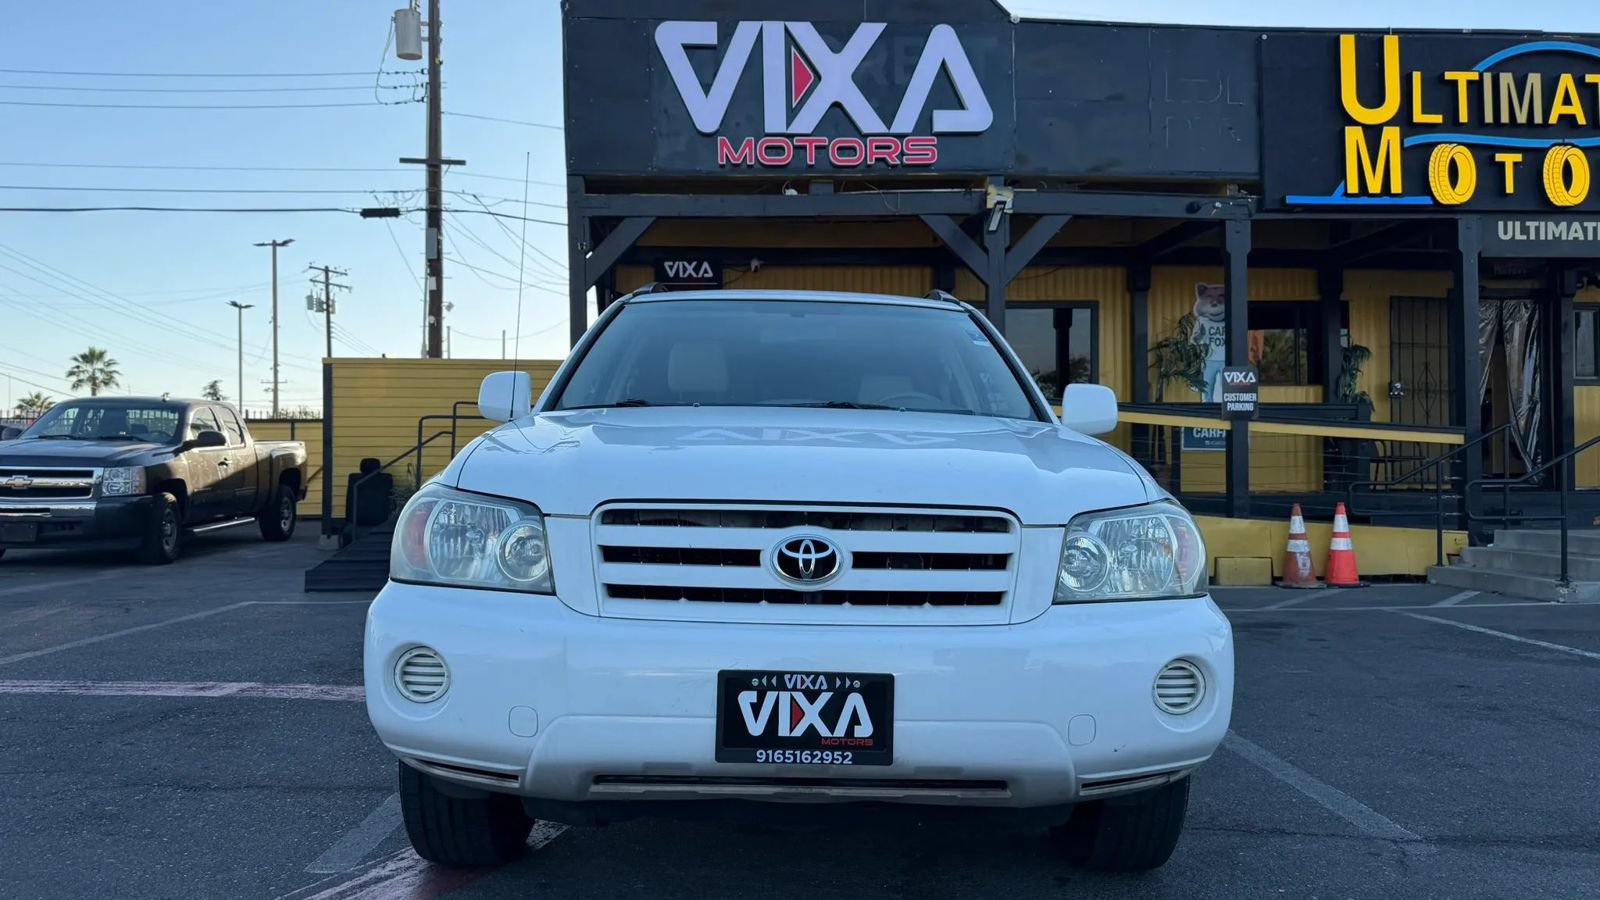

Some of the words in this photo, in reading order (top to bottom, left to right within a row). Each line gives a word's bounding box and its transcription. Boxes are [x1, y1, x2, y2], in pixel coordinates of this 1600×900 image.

[654, 20, 993, 134] VIXA
[717, 136, 937, 166] MOTORS
[1498, 220, 1600, 240] ULTIMAT
[663, 261, 714, 278] VIXA
[1224, 372, 1256, 383] VIXA
[1223, 393, 1257, 401] CUSTOMER
[1227, 403, 1254, 411] PARKING
[784, 674, 828, 690] VIXA
[737, 690, 874, 738] VIXA
[820, 738, 874, 747] MOTORS
[755, 749, 853, 765] 9165162952
